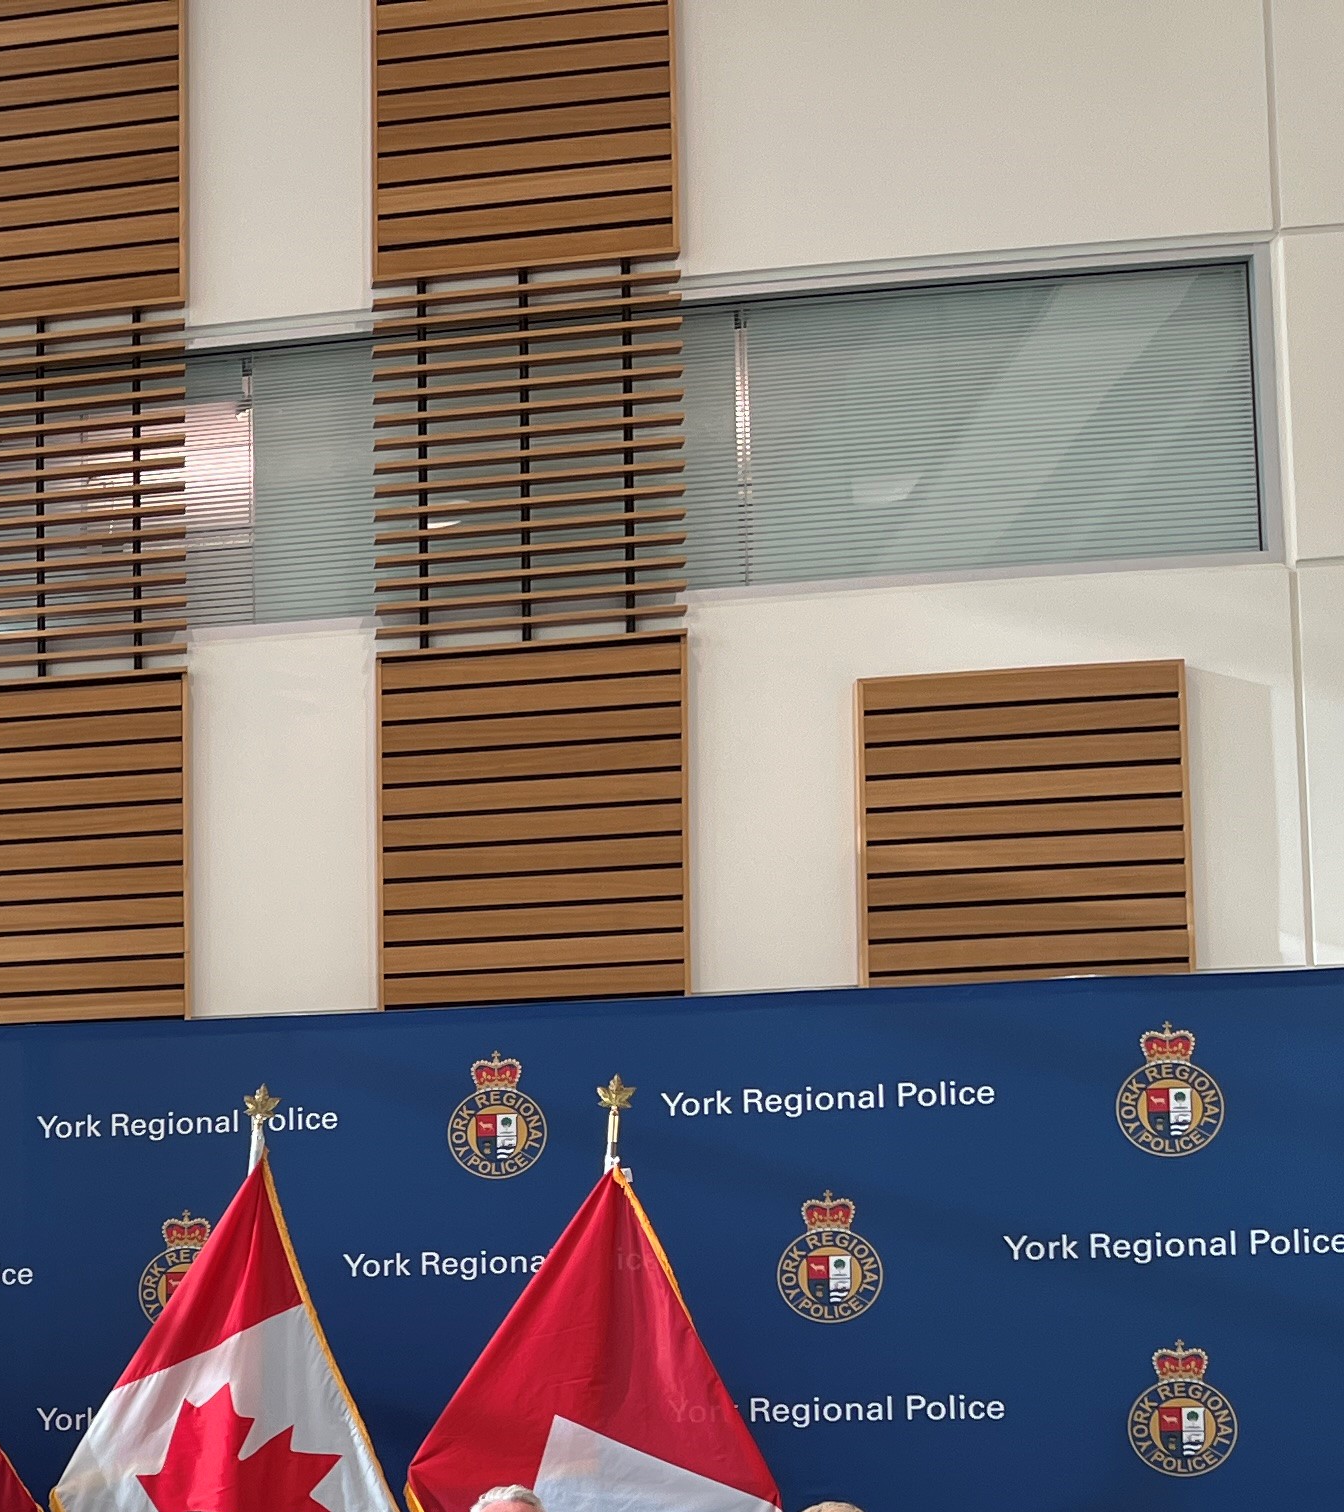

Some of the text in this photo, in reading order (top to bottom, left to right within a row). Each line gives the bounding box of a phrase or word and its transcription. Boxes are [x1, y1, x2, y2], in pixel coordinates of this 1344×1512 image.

[661, 1081, 995, 1118] York Regional Police
[1121, 1080, 1147, 1133] YORK
[1147, 1063, 1219, 1125] REGIONAL
[37, 1107, 338, 1141] York Regional olice
[453, 1106, 477, 1156] YORK
[477, 1090, 543, 1149] REGIONAL
[1138, 1129, 1203, 1154] POLICE
[468, 1153, 528, 1176] POLICE
[807, 1230, 877, 1291] REGIONAL
[1004, 1228, 1344, 1264] York Regional Police
[343, 1250, 544, 1281] York Regiona
[782, 1247, 807, 1298] YORK
[798, 1295, 862, 1319] POLICE
[751, 1394, 1005, 1428] Regional Police
[1133, 1399, 1160, 1452] YORK
[1160, 1382, 1232, 1445] REGIONAL
[1150, 1449, 1216, 1474] POLICE
